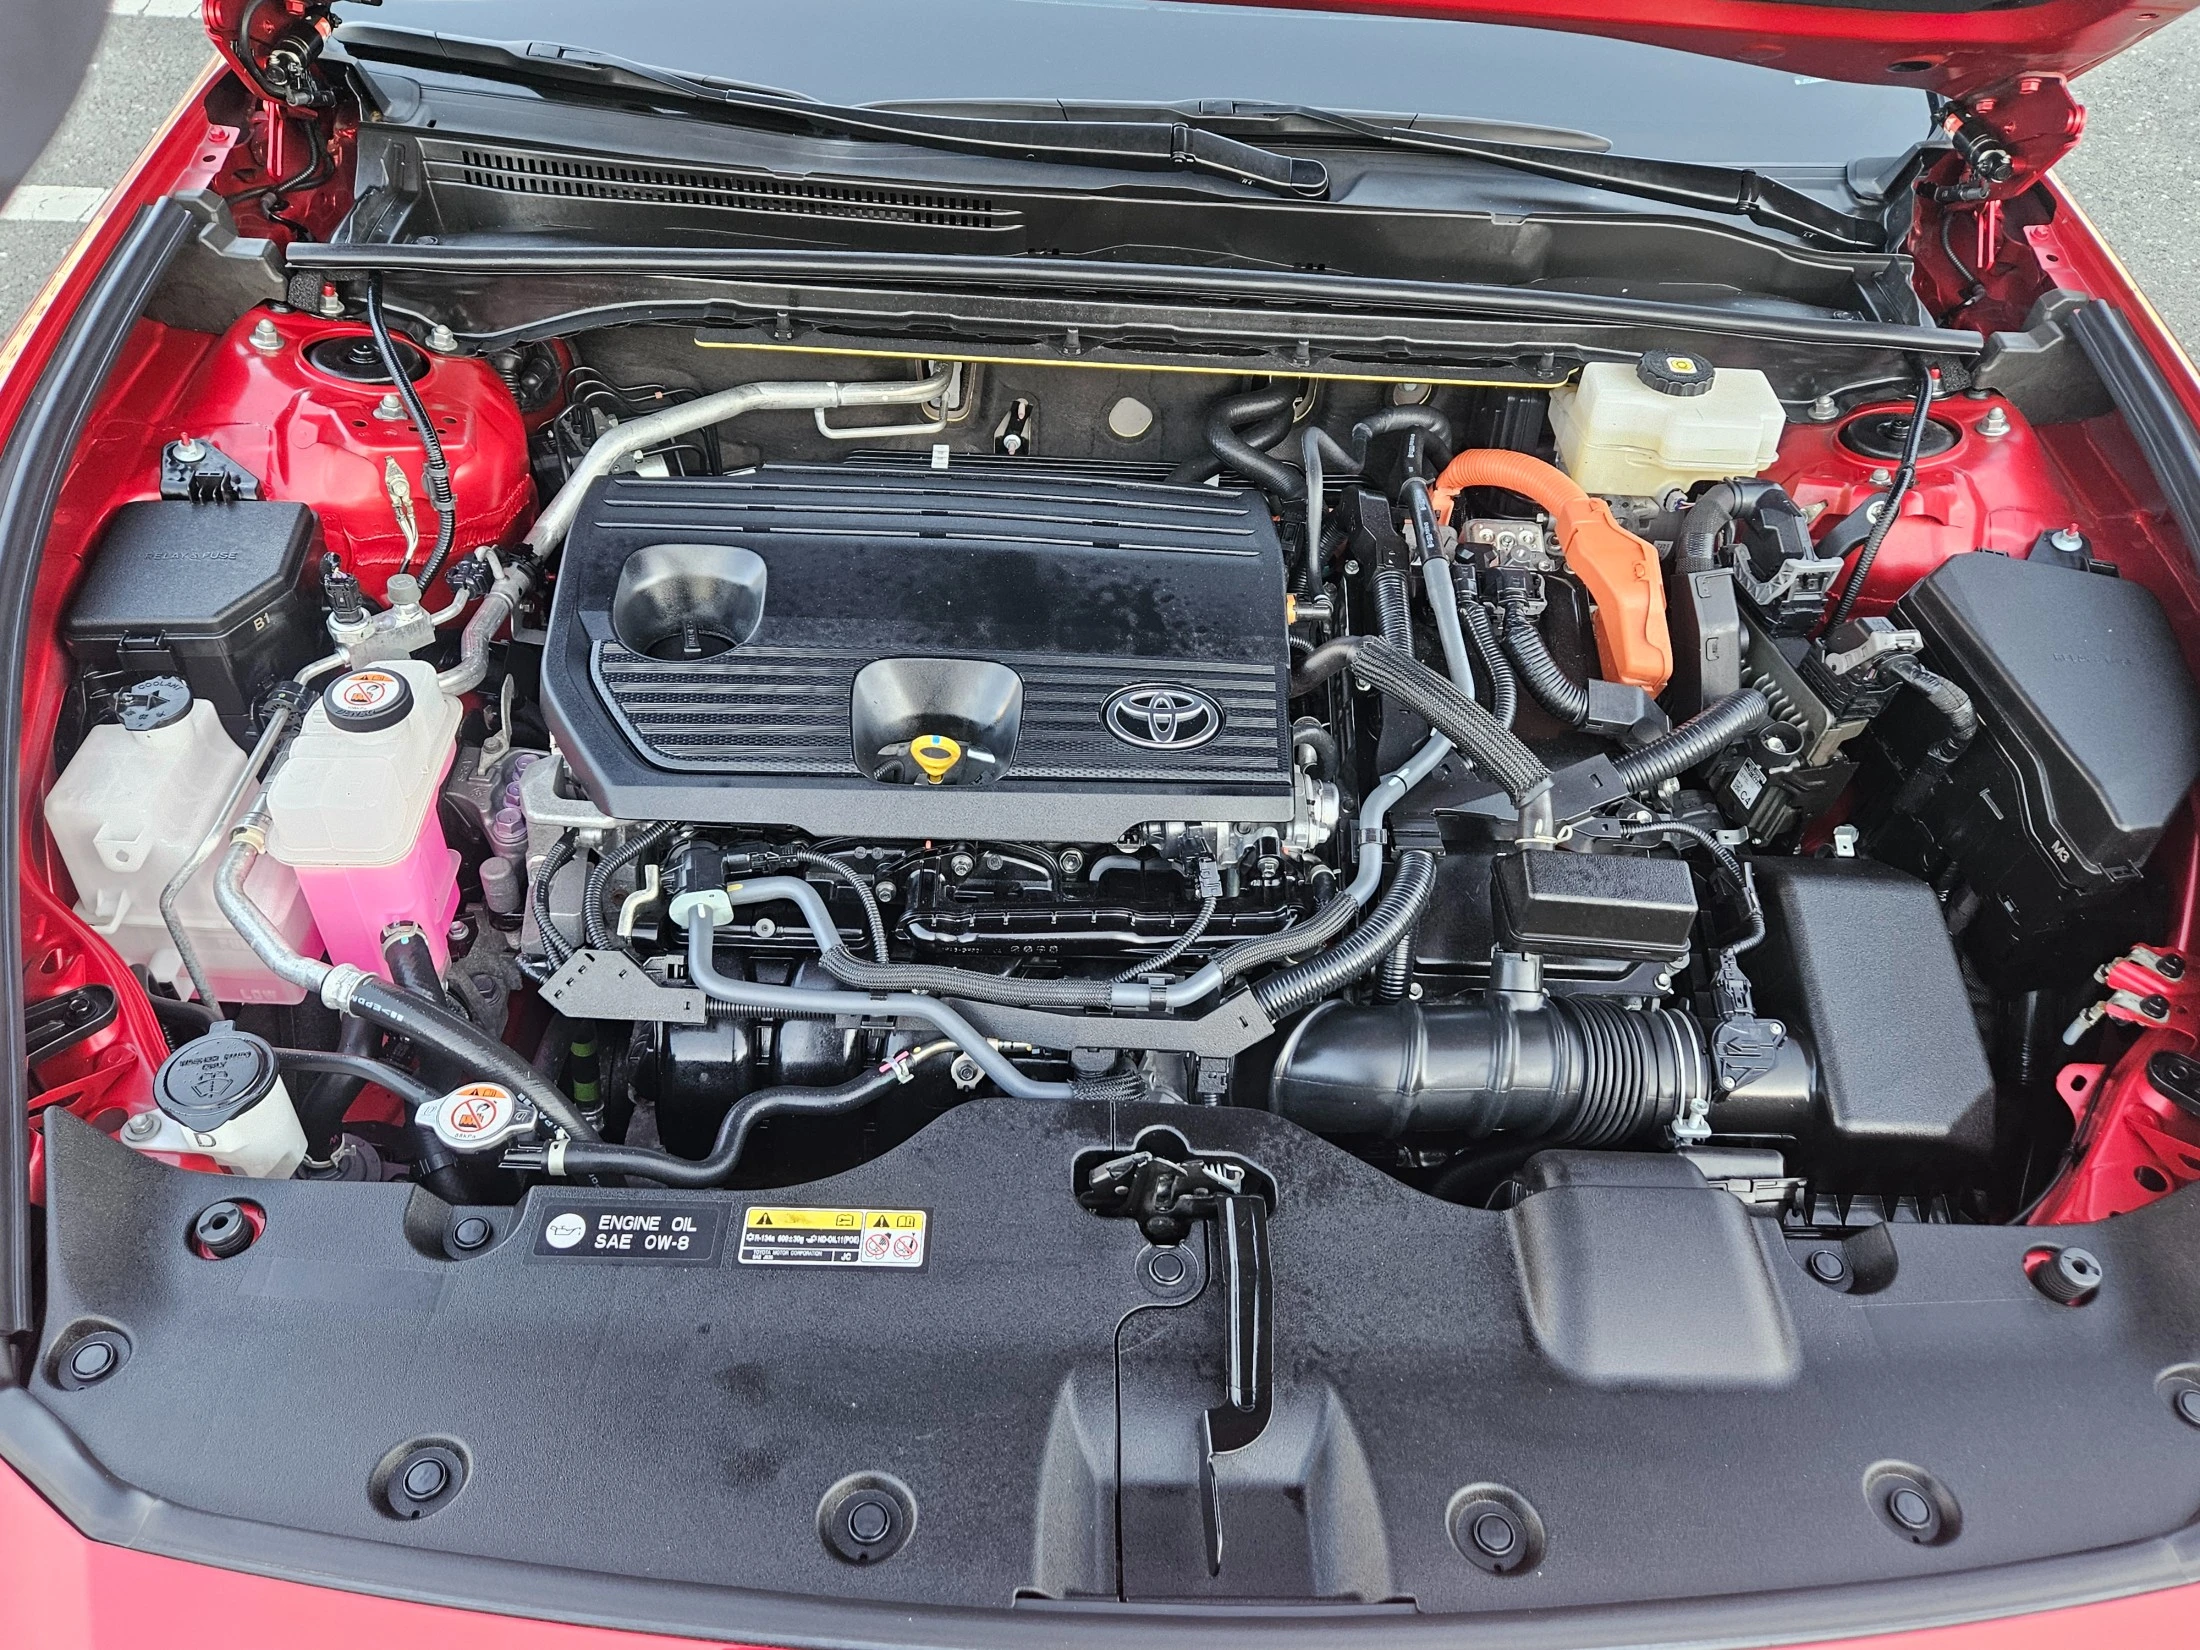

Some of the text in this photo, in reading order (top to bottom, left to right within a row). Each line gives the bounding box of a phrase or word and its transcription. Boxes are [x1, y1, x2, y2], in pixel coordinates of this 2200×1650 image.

[253, 612, 270, 631] B1
[138, 681, 184, 691] COOLANT
[2051, 839, 2070, 863] M3
[598, 1215, 697, 1232] ENGINE OIL
[594, 1234, 690, 1251] SAE 0W-8
